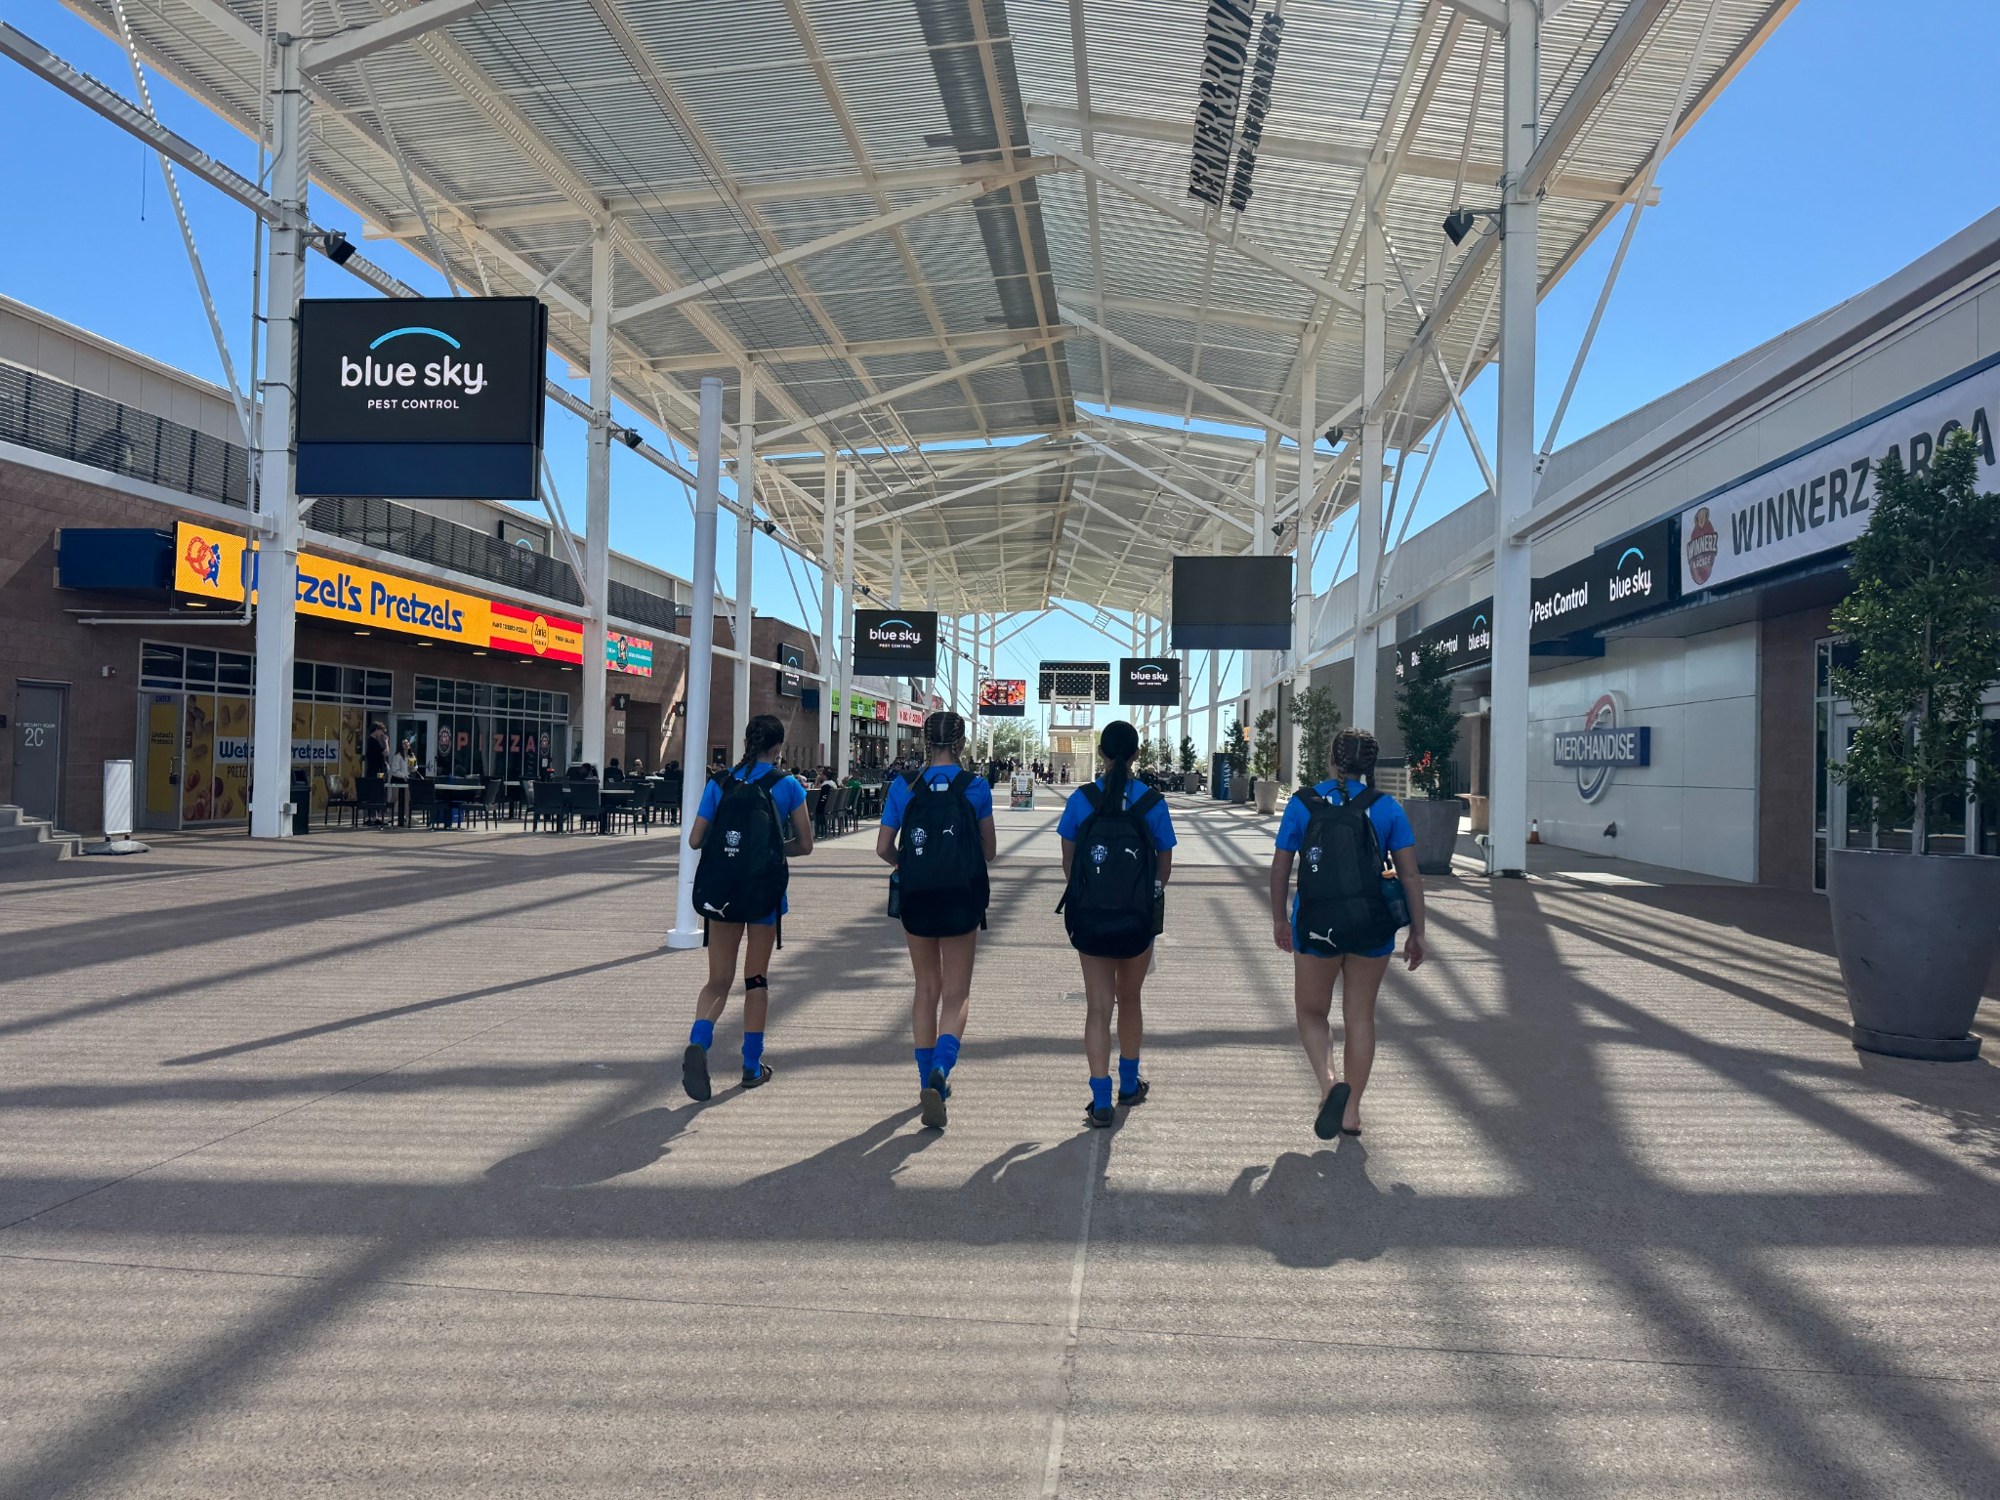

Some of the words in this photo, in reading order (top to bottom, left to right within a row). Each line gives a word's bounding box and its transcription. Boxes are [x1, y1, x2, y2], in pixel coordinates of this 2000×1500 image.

[1241, 13, 1283, 153] ATTORNEYS
[341, 355, 416, 388] blue
[424, 355, 485, 395] sky
[367, 399, 398, 409] PEST
[401, 399, 460, 410] CONTROL
[1731, 456, 1870, 556] WINNERZ
[1688, 533, 1717, 560] WINNERZ
[1609, 575, 1631, 602] blue
[1632, 567, 1652, 596] sky
[370, 580, 464, 633] Pretzels
[1534, 598, 1552, 623] Pest
[1553, 581, 1589, 616] Control
[869, 628, 898, 640] blue
[898, 629, 922, 644] sky
[1468, 633, 1481, 651] blue
[1480, 629, 1490, 649] sky
[1130, 671, 1151, 680] blue
[1151, 672, 1168, 682] sky
[24, 727, 44, 747] 2C
[457, 731, 536, 753] PIZZA
[1555, 732, 1635, 761] MERCHANDISE
[915, 847, 923, 856] 15
[1096, 866, 1100, 874] 1
[1311, 864, 1319, 873] 3
